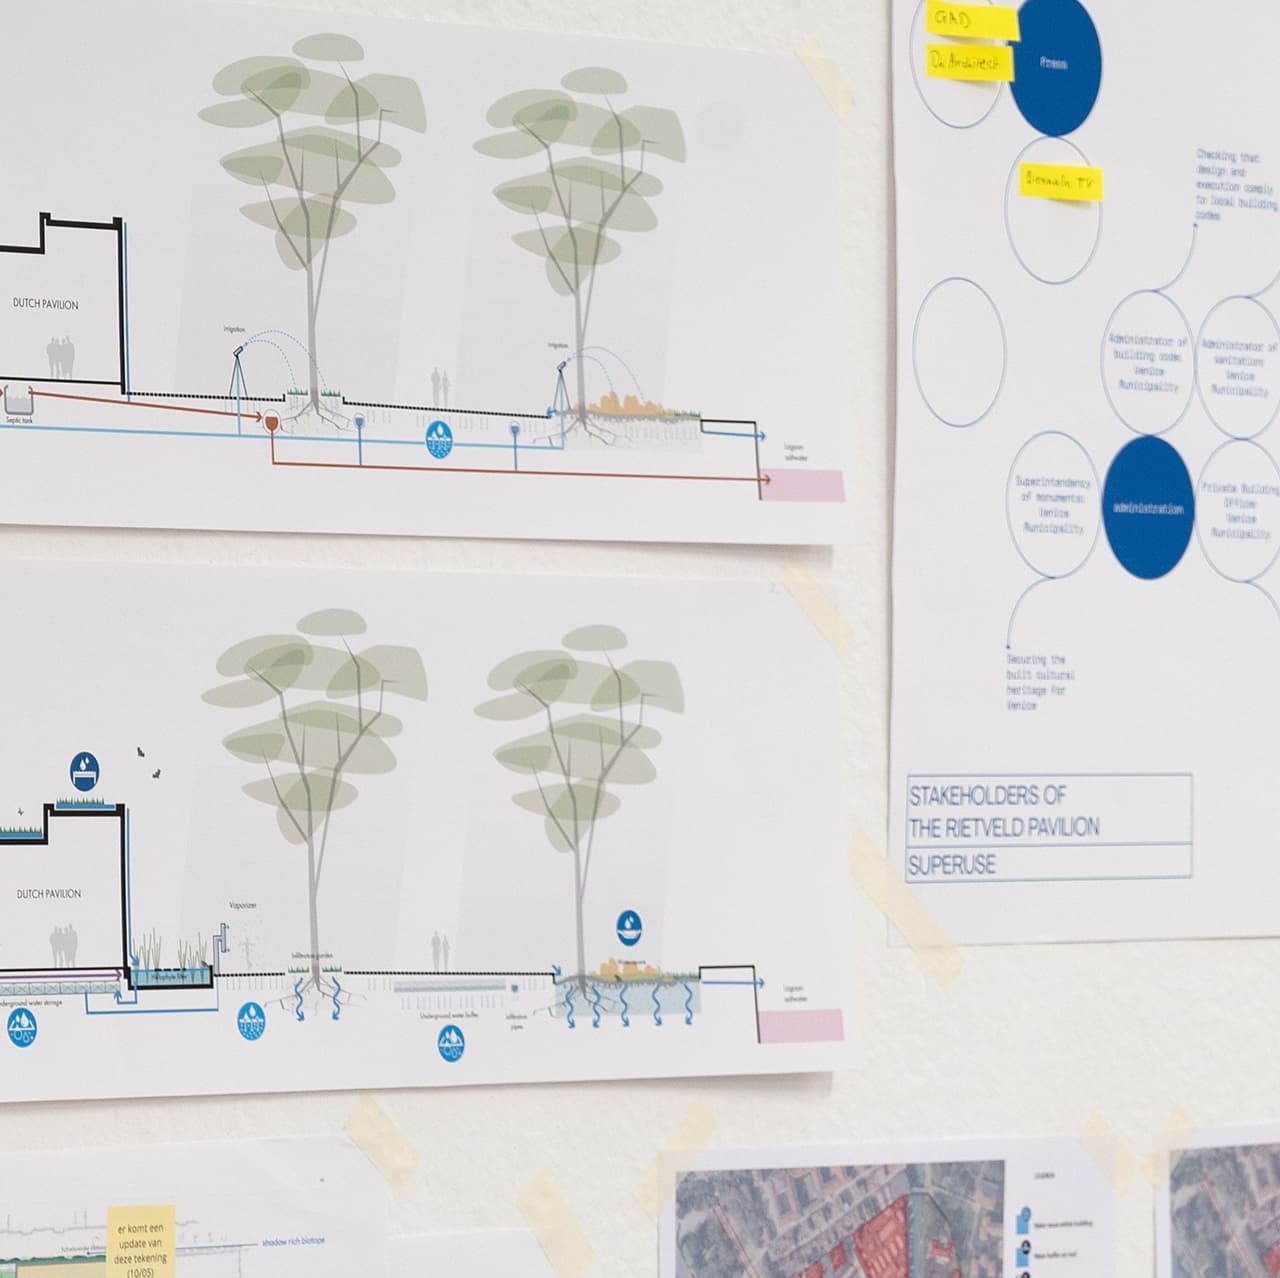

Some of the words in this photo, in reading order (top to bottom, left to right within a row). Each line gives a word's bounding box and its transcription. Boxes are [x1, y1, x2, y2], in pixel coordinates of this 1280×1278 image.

[13, 297, 40, 309] DUTCH
[42, 299, 79, 311] PAVILION
[910, 785, 1040, 806] STAKEHOLDERS
[1043, 785, 1067, 805] OF
[909, 818, 942, 838] THE
[945, 817, 1025, 837] RIETVELD
[1028, 816, 1100, 837] PAVILION
[908, 853, 997, 876] SUPERUSE
[17, 889, 44, 899] DUTCH
[46, 889, 81, 899] PAVILION
[117, 1225, 126, 1235] er
[127, 1224, 147, 1234] komt
[149, 1225, 164, 1234] een
[119, 1238, 147, 1250] update
[149, 1239, 162, 1248] van
[262, 1238, 286, 1248] shadow
[288, 1237, 300, 1247] rich
[300, 1236, 326, 1247] biotope
[114, 1254, 132, 1264] deze
[134, 1253, 167, 1265] tekening
